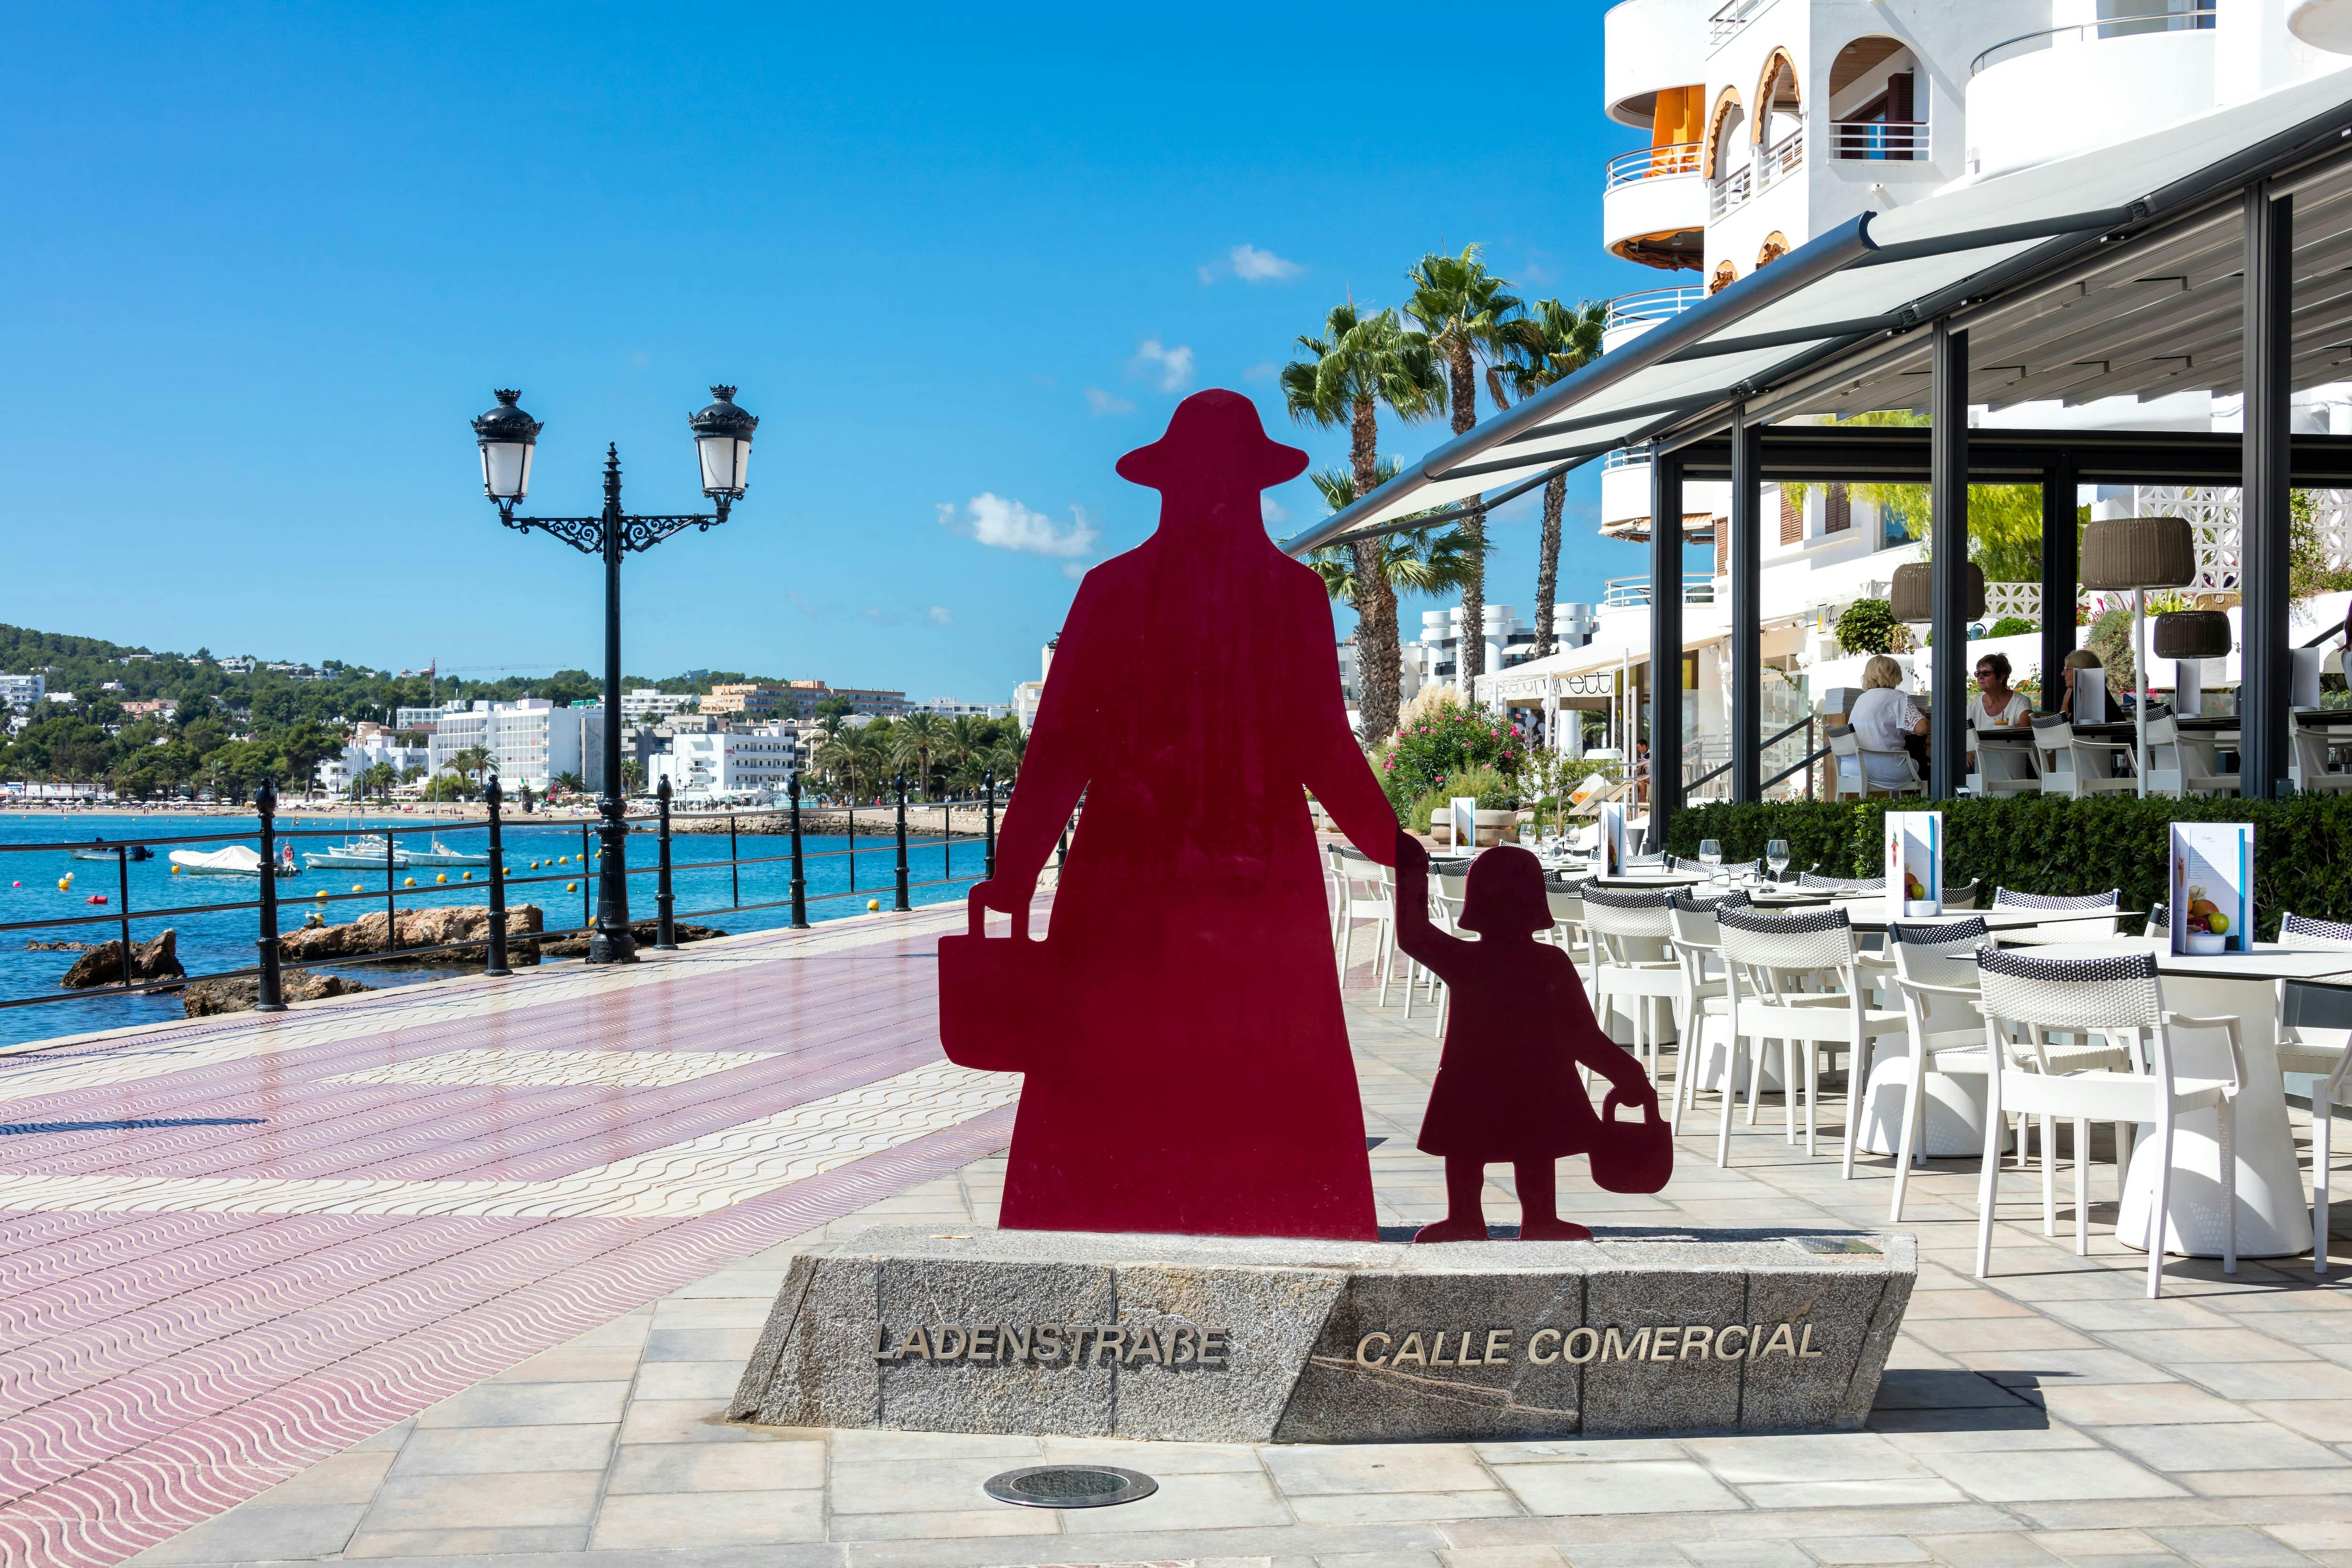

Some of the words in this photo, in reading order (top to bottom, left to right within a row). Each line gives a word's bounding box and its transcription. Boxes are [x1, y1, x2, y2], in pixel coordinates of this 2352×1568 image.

[872, 1323, 1226, 1366] LADENSTRAßE
[1357, 1329, 1513, 1367] CALLE
[1527, 1323, 1822, 1364] COMERCIAL
